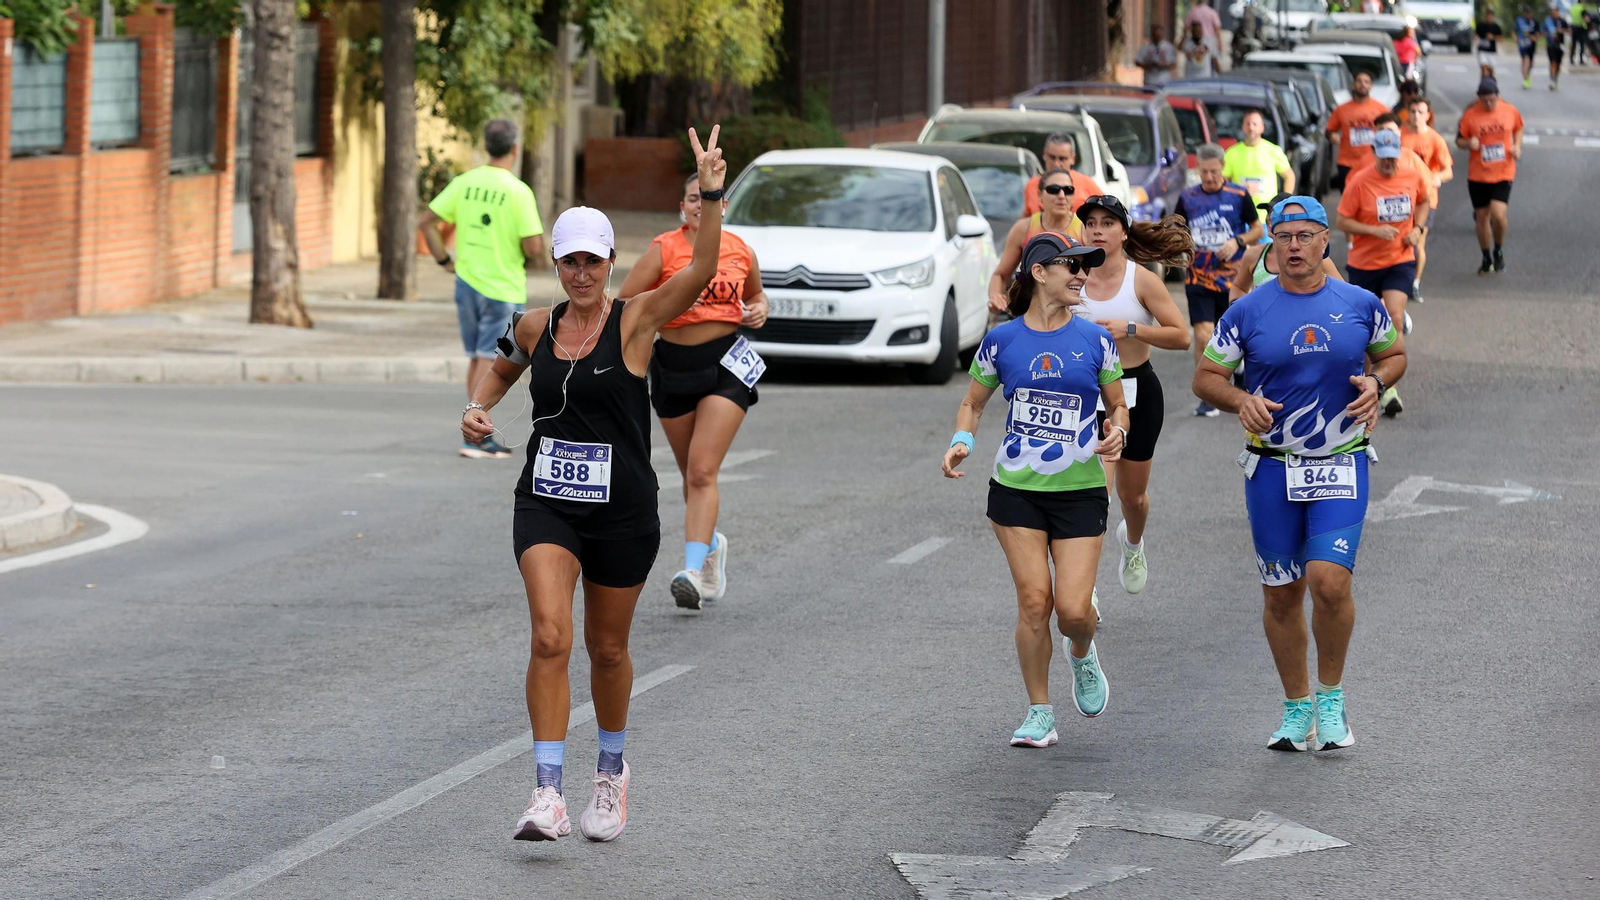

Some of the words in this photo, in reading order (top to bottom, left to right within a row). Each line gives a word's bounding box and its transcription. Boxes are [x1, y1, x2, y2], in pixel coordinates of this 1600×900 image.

[465, 187, 506, 206] STAFF
[741, 349, 756, 368] 97
[1028, 406, 1063, 426] 950
[1033, 429, 1072, 441] MIZUNO
[550, 460, 590, 482] 588
[1303, 467, 1339, 484] 846
[557, 486, 603, 498] MIZUNO
[1312, 488, 1352, 497] MIZUNO
